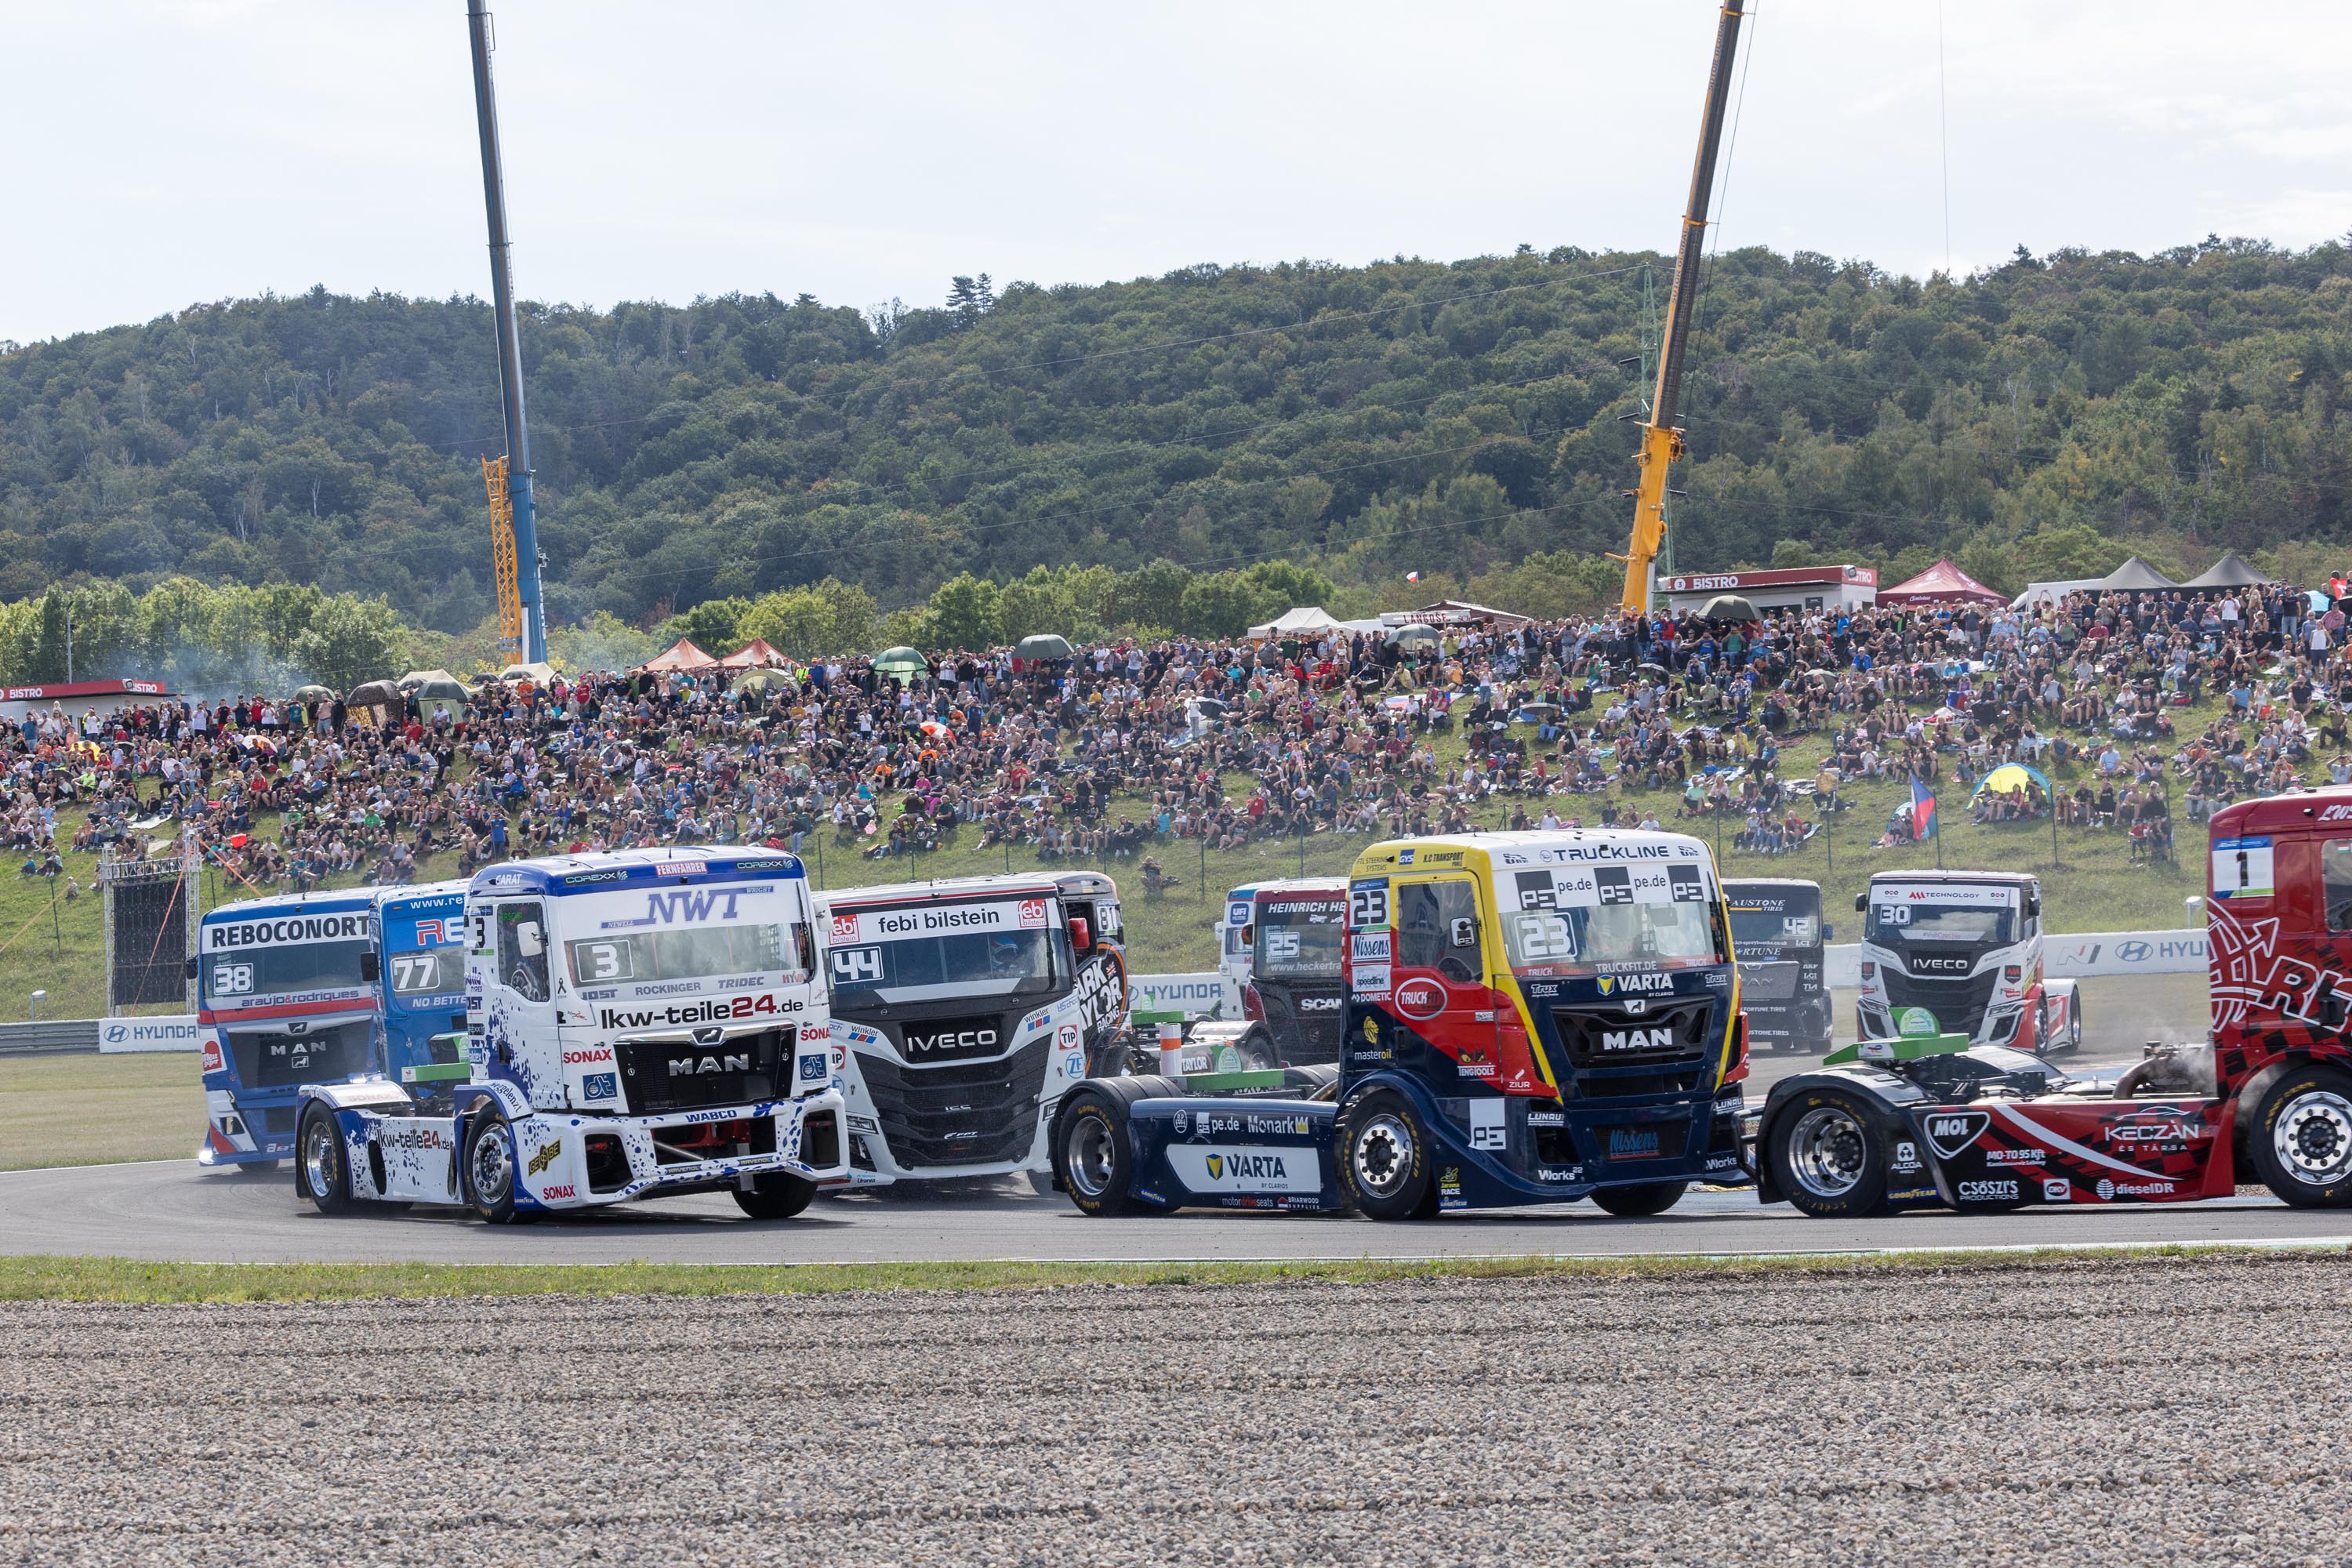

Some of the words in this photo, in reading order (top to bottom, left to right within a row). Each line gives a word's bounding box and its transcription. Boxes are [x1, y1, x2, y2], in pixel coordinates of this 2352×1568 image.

[1693, 575, 1738, 590] BISTRO
[9, 688, 42, 699] BISTRO
[1553, 846, 1669, 862] TRUCKLINE
[656, 862, 707, 876] FERNFAHRER
[2236, 851, 2249, 887] 1
[495, 874, 522, 885] CARAT
[1557, 878, 1592, 895] pe.de
[1634, 874, 1666, 891] pe.de
[645, 890, 739, 924] NWT
[1268, 902, 1327, 913] HEINRICH
[1354, 891, 1386, 925] 23
[878, 914, 918, 933] febi
[924, 908, 1000, 928] bilstein
[1882, 906, 1910, 924] 30
[608, 920, 634, 928] NEWELL
[1784, 919, 1809, 935] 42
[212, 916, 369, 949] REBOCONORT
[1521, 918, 1571, 956] 23
[1269, 934, 1298, 956] 25
[1352, 935, 1389, 956] Nissens
[591, 944, 619, 978] 3
[833, 949, 881, 980] 44
[1595, 961, 1657, 973] TRUCKFIT.DE
[1913, 959, 1968, 970] IVECO
[214, 966, 252, 993] 38
[394, 956, 434, 990] 77
[1705, 974, 1727, 983] Trux
[635, 982, 701, 996] ROCKINGER
[718, 977, 764, 989] TRIDEC
[1530, 984, 1559, 994] Trux
[1617, 973, 1674, 991] VARTA
[241, 989, 359, 1007] araújo&rodrigues
[412, 997, 430, 1008] NO
[1361, 992, 1392, 1003] DOMETIC
[601, 995, 804, 1029] lkw-teile24.de
[1024, 1007, 1050, 1023] winkler
[851, 1025, 879, 1036] winkler
[1061, 1032, 1077, 1044] TIP
[907, 1029, 997, 1051] IVECO
[1602, 1029, 1673, 1050] MAN
[270, 1041, 328, 1055] MAN
[1355, 1049, 1392, 1060] masteroil
[563, 1049, 613, 1063] SONAX
[669, 1054, 749, 1076] MAN
[1182, 1056, 1207, 1072] TAYLOR
[685, 1109, 738, 1123] WABCO
[1211, 1116, 1240, 1131] pe.de
[1247, 1115, 1294, 1134] Monark
[1933, 1118, 1969, 1137] MOL
[1609, 1129, 1660, 1153] Nissens
[740, 1156, 772, 1165] RAVENOL
[1226, 1156, 1287, 1178] VARTA
[1890, 1161, 1924, 1170] ALCOA
[667, 1165, 701, 1174] RAVENOL
[1537, 1170, 1576, 1181] Works
[543, 1185, 576, 1200] SONAX
[1887, 1189, 1937, 1200] GOODYEAR
[2116, 1183, 2175, 1196] dieselDR
[1221, 1196, 1274, 1207] motordriveseats
